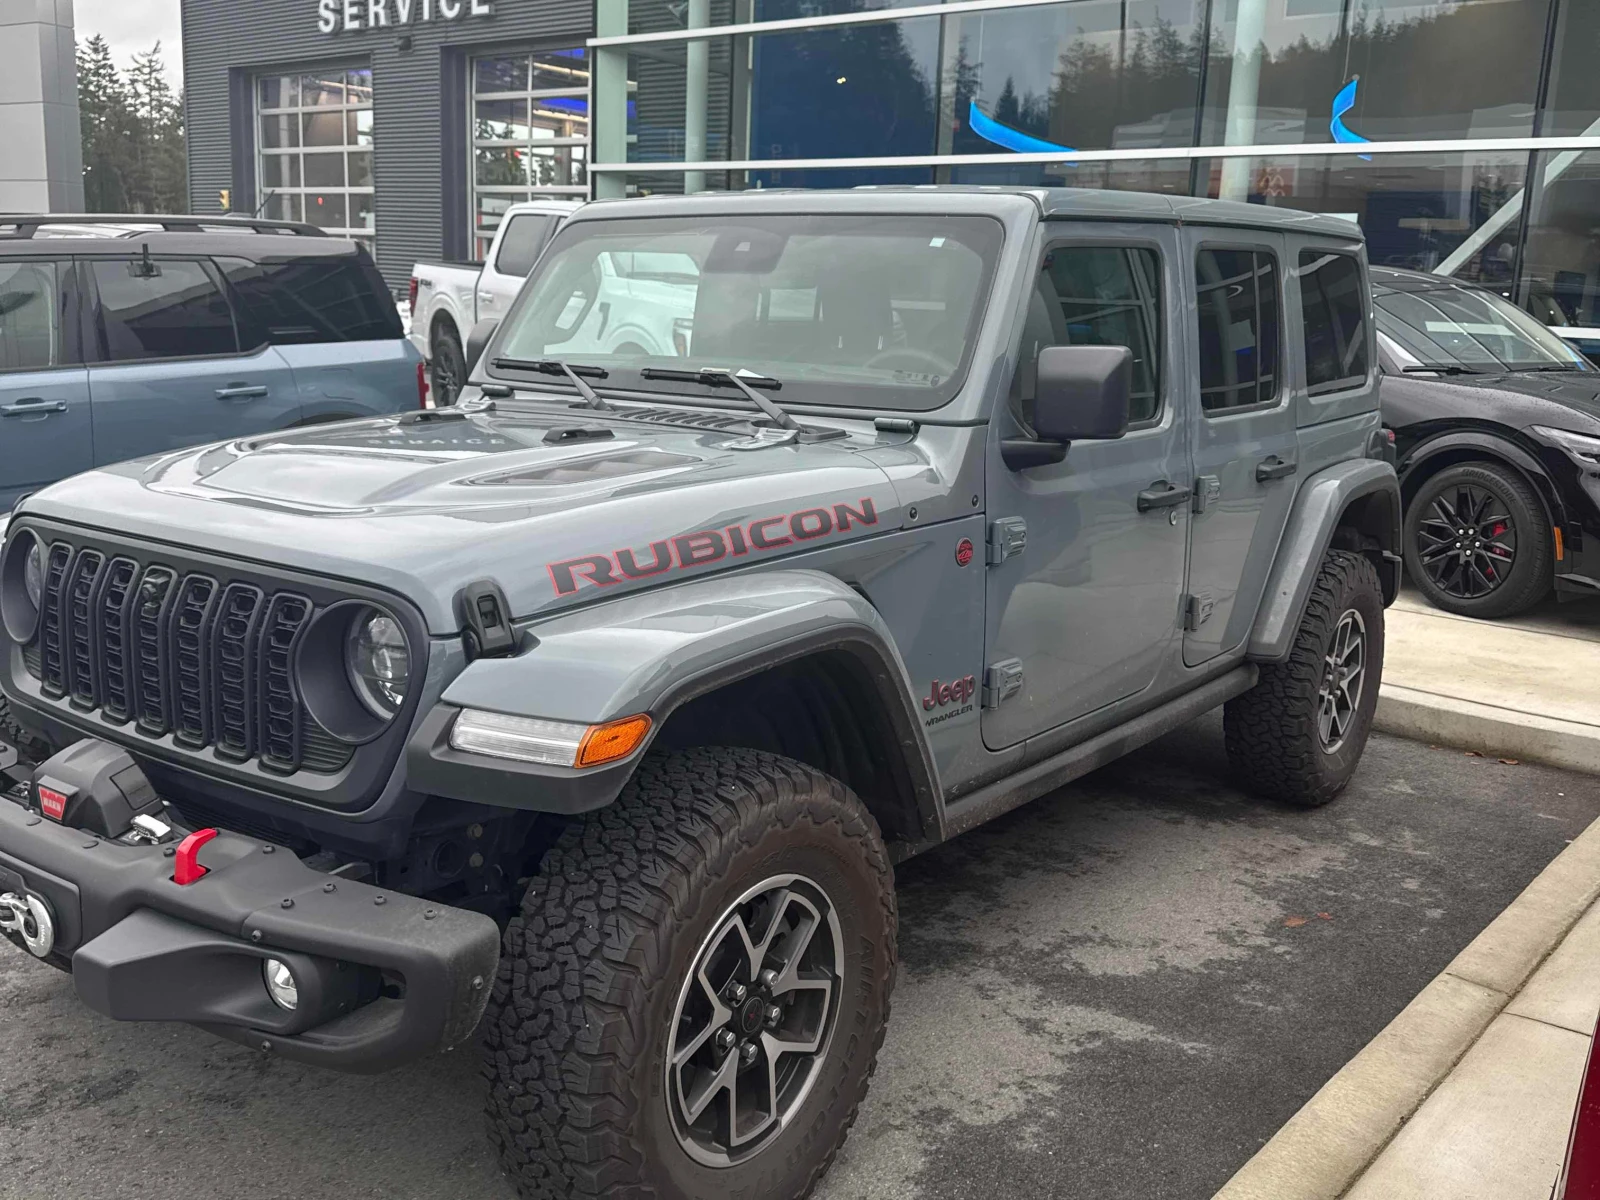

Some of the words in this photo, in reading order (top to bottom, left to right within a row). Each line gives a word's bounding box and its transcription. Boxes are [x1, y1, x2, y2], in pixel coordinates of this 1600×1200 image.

[546, 498, 878, 596] RUBICON
[922, 674, 976, 712] Jeep
[925, 704, 973, 727] WRANGLER
